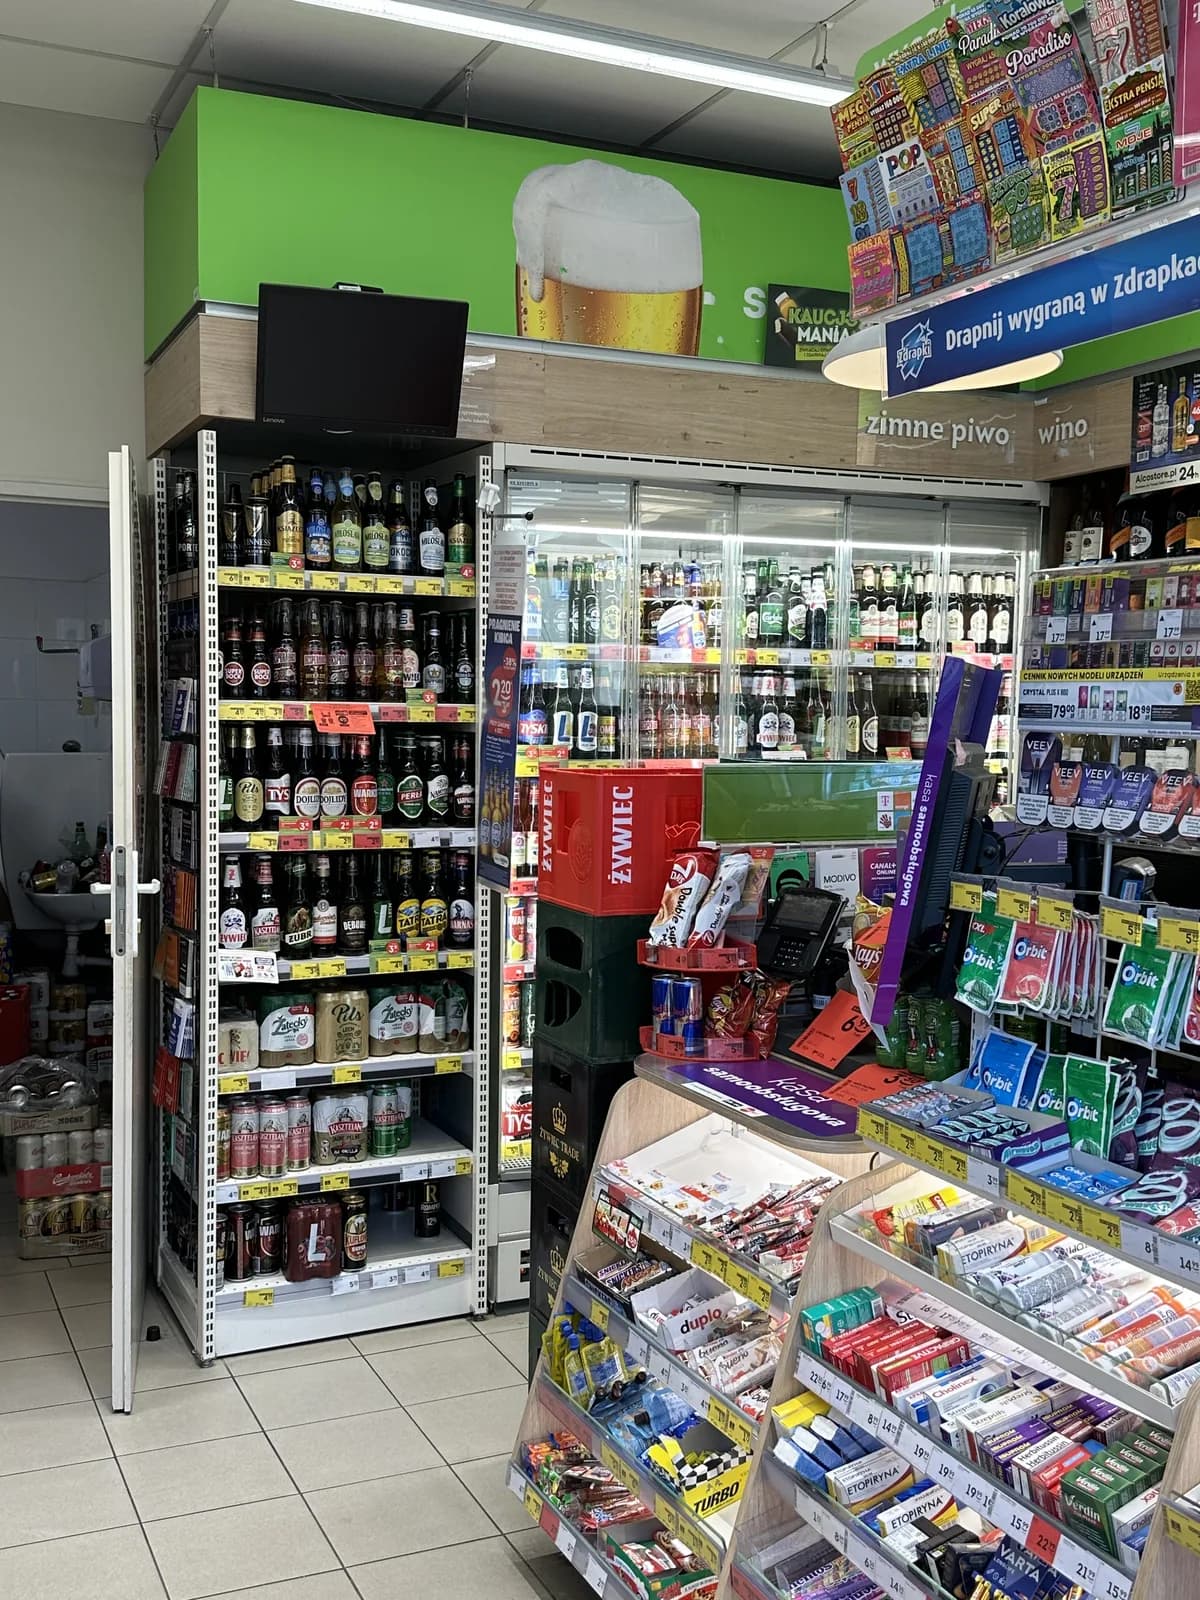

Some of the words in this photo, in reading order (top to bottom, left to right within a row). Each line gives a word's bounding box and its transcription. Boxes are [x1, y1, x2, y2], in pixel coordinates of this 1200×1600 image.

[1005, 31, 1073, 76] Paradiso
[1103, 86, 1136, 114] EKSTRA
[1135, 71, 1164, 97] PENSJA
[838, 101, 864, 127] MEG
[970, 97, 1001, 130] SUPER
[1115, 128, 1153, 150] MOJE
[885, 143, 921, 177] POP
[946, 311, 1003, 351] Drapnij
[1007, 289, 1086, 334] wygraną
[1091, 282, 1108, 305] w
[897, 339, 932, 367] zdrapki
[263, 416, 285, 424] Lenovo
[867, 411, 943, 440] zimne
[951, 418, 1009, 449] piwo
[1039, 417, 1088, 444] wino
[1135, 468, 1177, 483] Alcostore.pl
[1179, 465, 1195, 481] 24
[391, 547, 410, 556] OKOC
[1023, 671, 1047, 680] CENNIK
[1048, 671, 1078, 680] NOWYCH
[1079, 671, 1105, 680] MODELI
[1023, 688, 1045, 696] CRYSTAL
[520, 723, 548, 734] TYSKI
[1026, 740, 1054, 750] VEEV
[1055, 767, 1080, 778] VEEV
[1085, 768, 1111, 779] VEEV
[1121, 771, 1149, 783] VEEV
[1161, 774, 1193, 786] VEEV
[268, 789, 289, 801] TYS
[921, 774, 938, 810] kasa
[542, 779, 554, 873] ŻYWIEC
[609, 785, 633, 885] ŻYWIEC
[870, 862, 896, 870] CANAL+
[900, 807, 929, 907] samoobsługowa
[823, 873, 857, 884] MODIVO
[672, 887, 692, 923] Double
[399, 915, 420, 927] TATR
[421, 912, 447, 928] TATRA
[855, 944, 882, 969] Lay's
[963, 946, 996, 971] Orbit
[1014, 939, 1047, 960] Orbit
[1122, 963, 1159, 989] Orbit
[331, 1003, 365, 1024] Pils
[767, 1077, 832, 1104] kasa
[983, 1069, 1014, 1094] Orbit
[703, 1067, 846, 1127] samoobsługowa
[506, 1112, 532, 1131] TYS
[1067, 1100, 1099, 1123] Orbit
[425, 1185, 437, 1202] R
[307, 1223, 326, 1262] L
[961, 1239, 1014, 1265] ETOPIRYNA
[606, 1262, 644, 1286] SNICKERS
[680, 1305, 723, 1335] duplo
[697, 1337, 729, 1359] bueno
[752, 1390, 769, 1402] bue
[932, 1376, 978, 1399] Cholinex
[1017, 1434, 1060, 1461] Herbitussin
[1025, 1439, 1069, 1467] Herbitussin
[847, 1466, 900, 1496] ETOPIRYNA
[694, 1481, 741, 1516] TURBO
[1064, 1493, 1101, 1522] Verdin
[891, 1496, 943, 1530] ETOPIRYNA
[1000, 1543, 1040, 1583] VARTA
